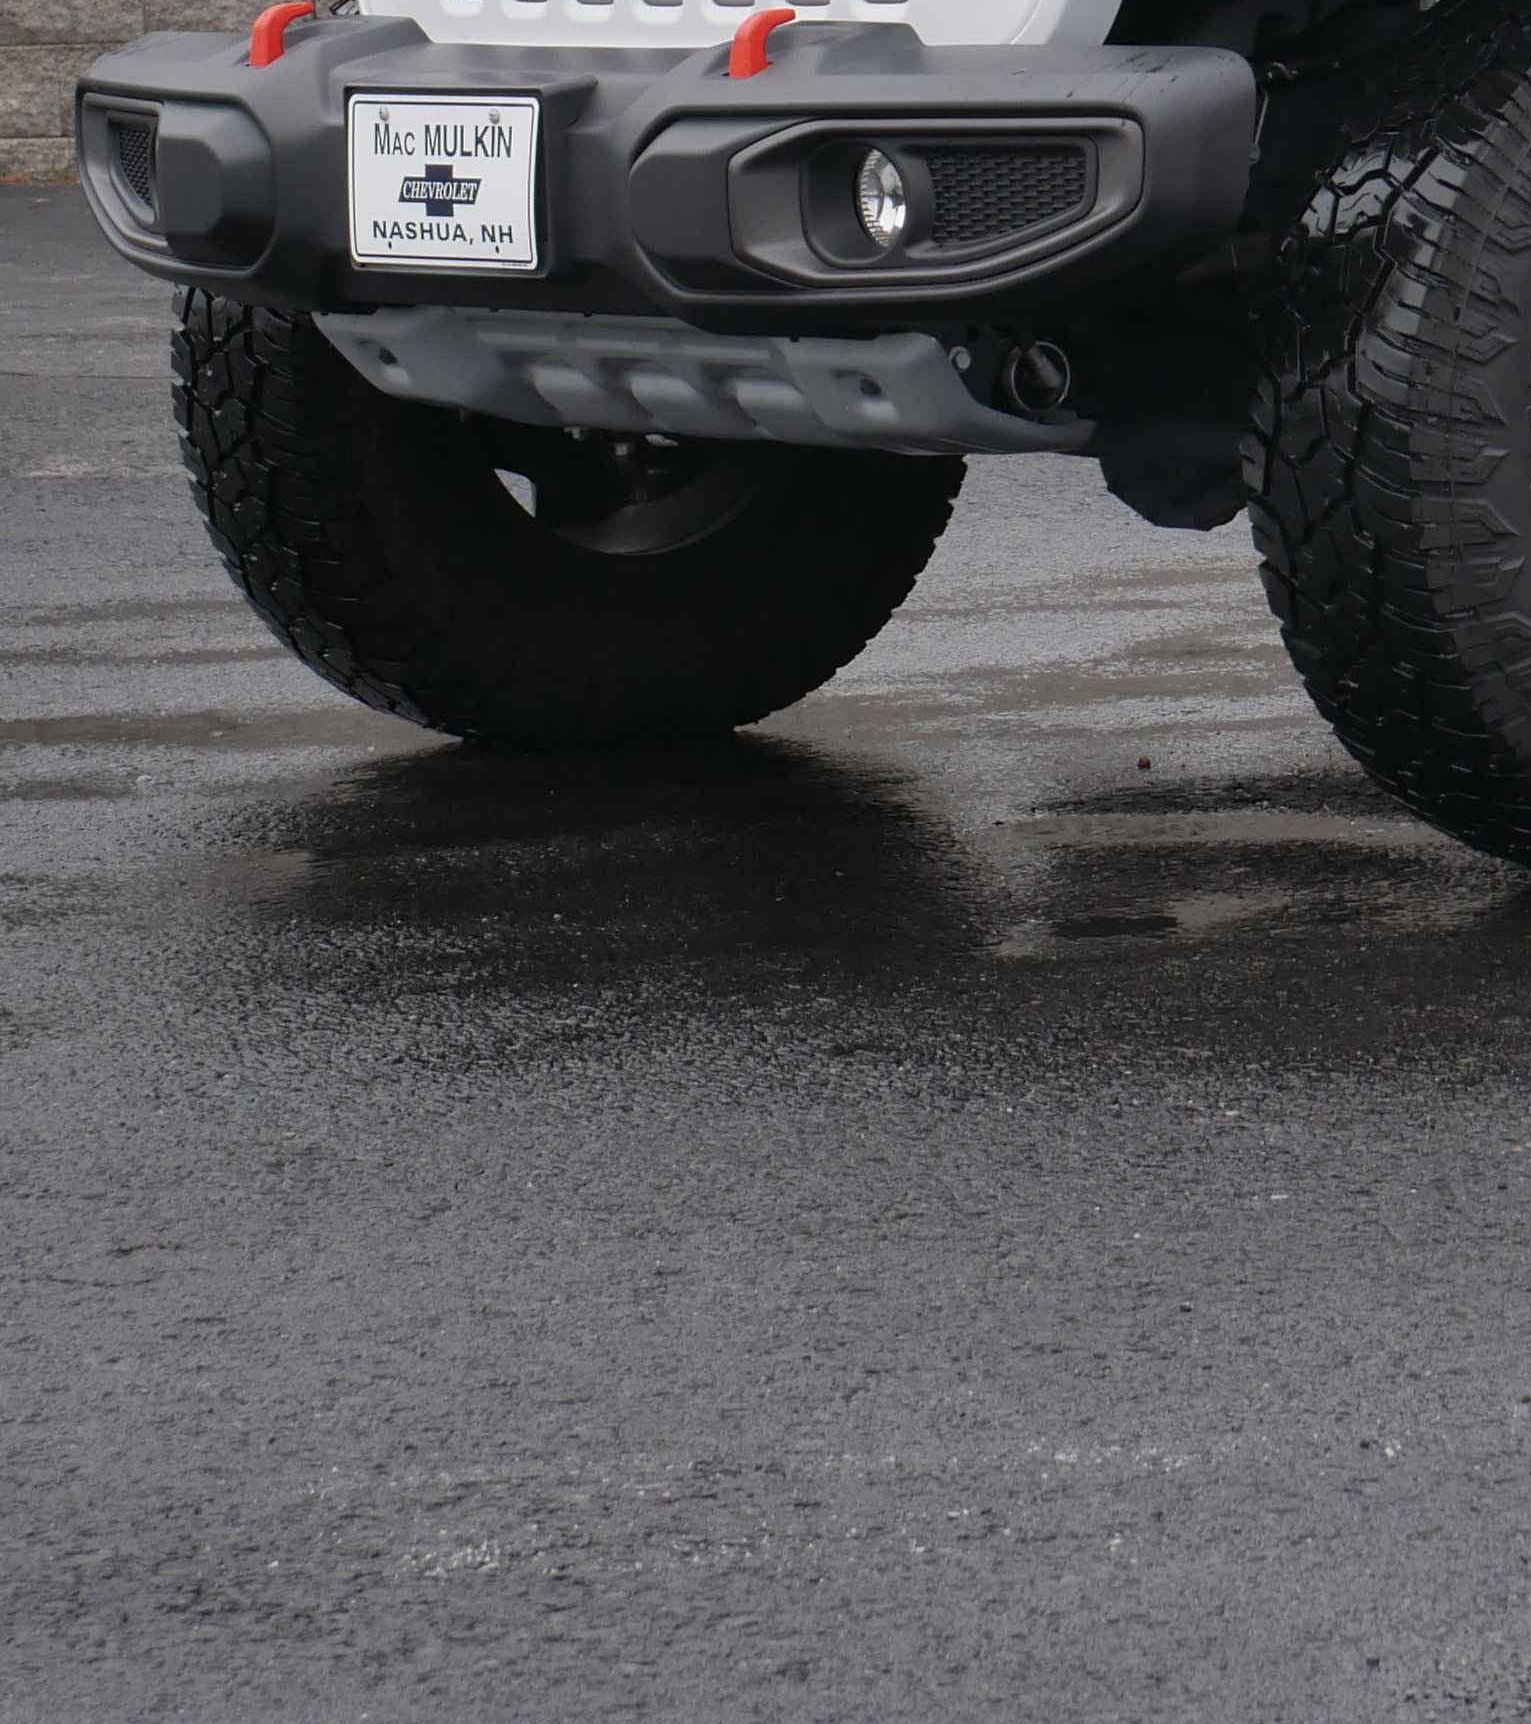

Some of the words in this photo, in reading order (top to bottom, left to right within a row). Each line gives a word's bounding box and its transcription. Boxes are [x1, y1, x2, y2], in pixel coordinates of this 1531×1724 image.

[424, 124, 513, 158] MULKIN
[403, 180, 479, 201] CHEVROLET
[372, 220, 475, 245] NASHUA,
[481, 224, 514, 244] NH
